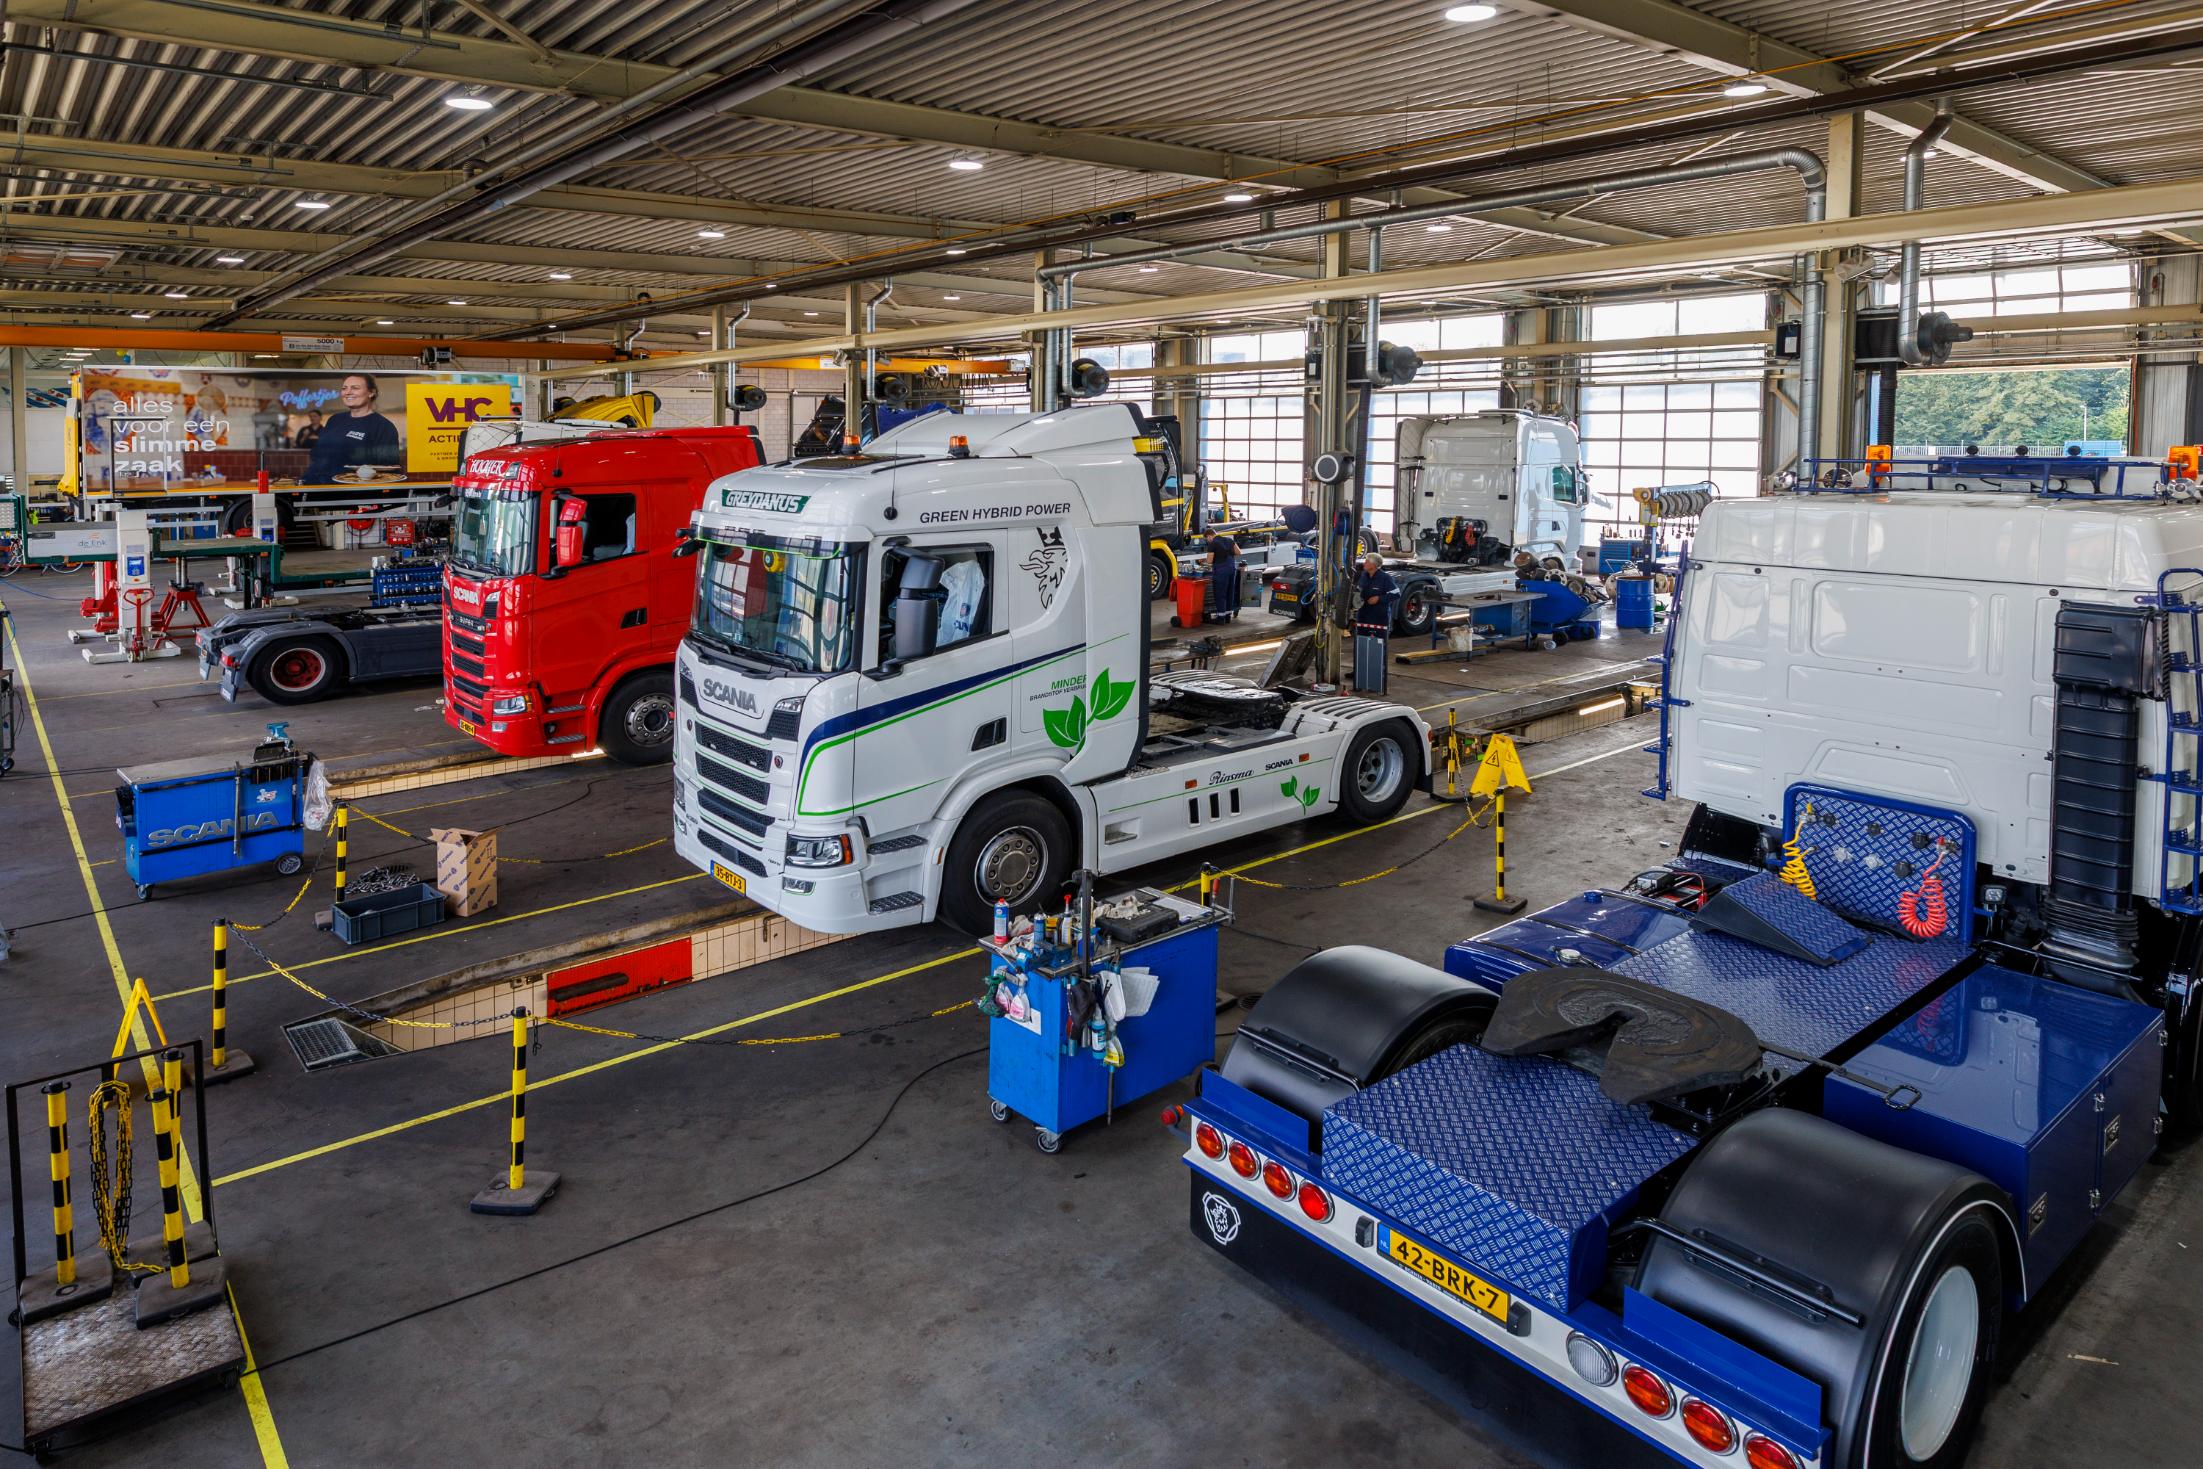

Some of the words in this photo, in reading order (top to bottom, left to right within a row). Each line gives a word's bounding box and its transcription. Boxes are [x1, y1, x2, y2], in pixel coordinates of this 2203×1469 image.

[113, 396, 173, 413] alles
[424, 397, 493, 422] VHC
[114, 420, 175, 433] voor
[114, 436, 217, 453] slimme
[114, 456, 184, 472] zaak
[725, 490, 800, 513] GREYDANUS
[919, 509, 969, 524] GREEN
[972, 506, 1022, 520] HYBRID
[1025, 503, 1071, 516] POWER
[453, 585, 480, 606] SCANIA
[1273, 608, 1296, 617] SCANIA
[703, 677, 758, 714] SCANIA
[1265, 758, 1293, 771] SCANIA
[1208, 769, 1255, 785] Rinsma
[148, 811, 281, 848] SCANIA
[1396, 1240, 1499, 1311] 42-BRK-7
